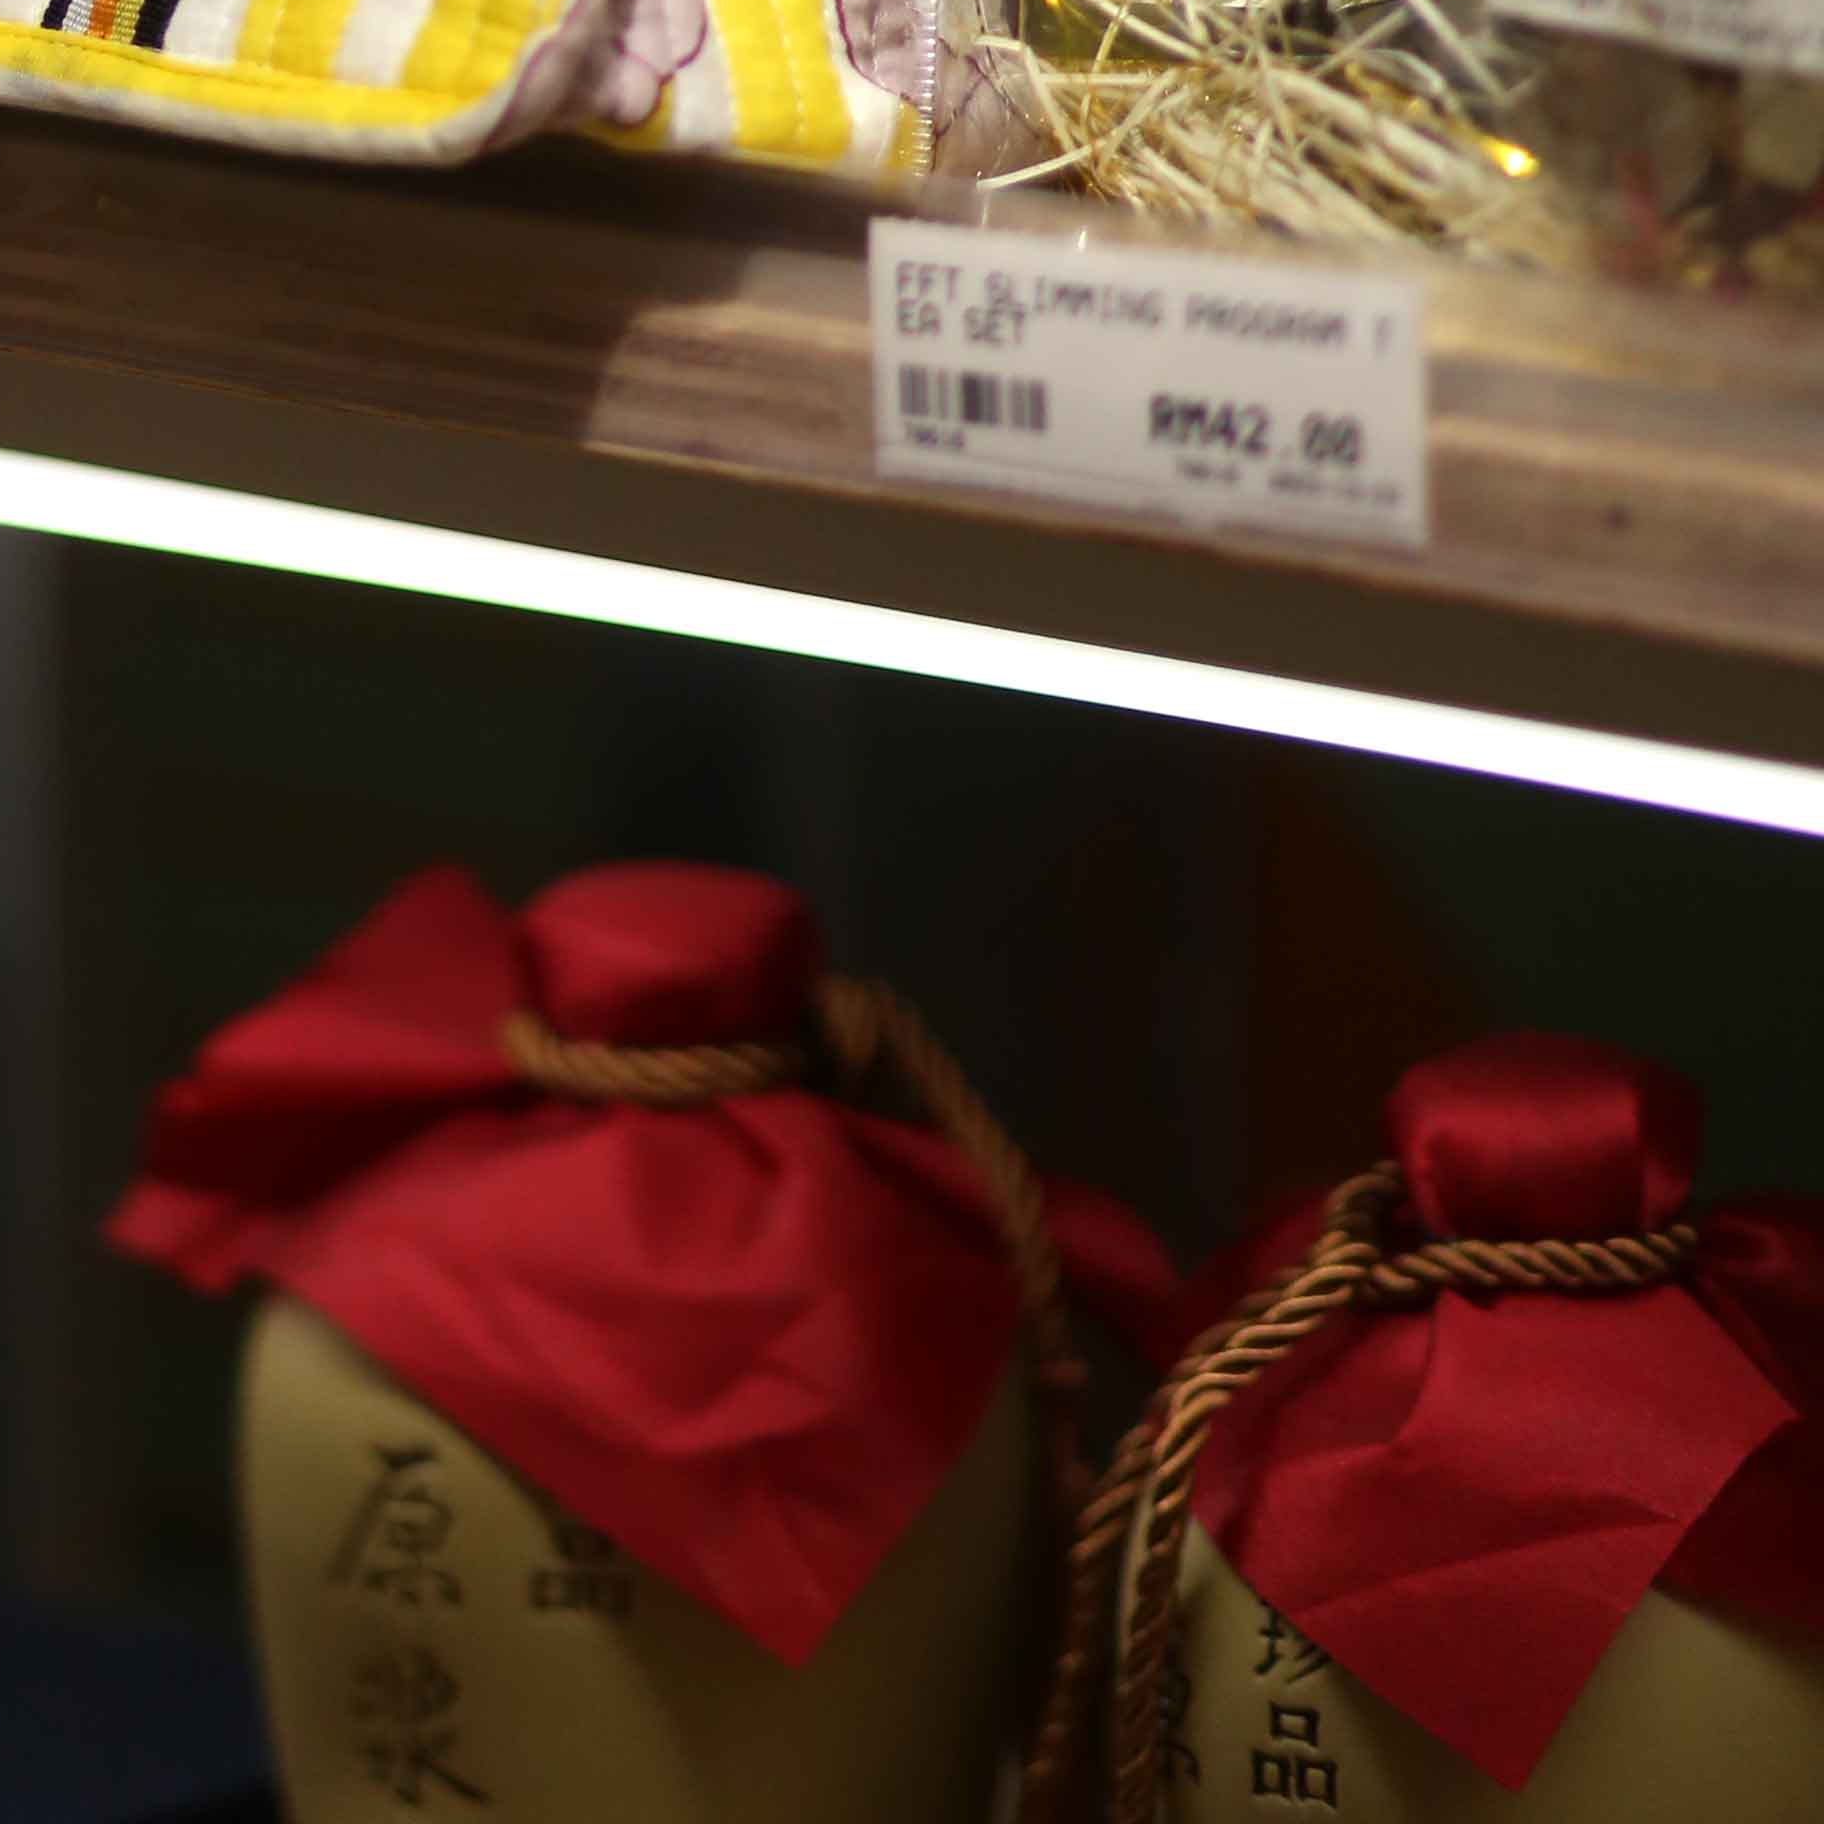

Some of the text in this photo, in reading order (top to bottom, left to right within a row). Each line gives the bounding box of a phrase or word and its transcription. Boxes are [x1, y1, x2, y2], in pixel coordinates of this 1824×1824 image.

[894, 297, 1028, 348] EA SET
[984, 270, 1162, 331] SLIMMING
[1149, 390, 1364, 468] RM42.00
